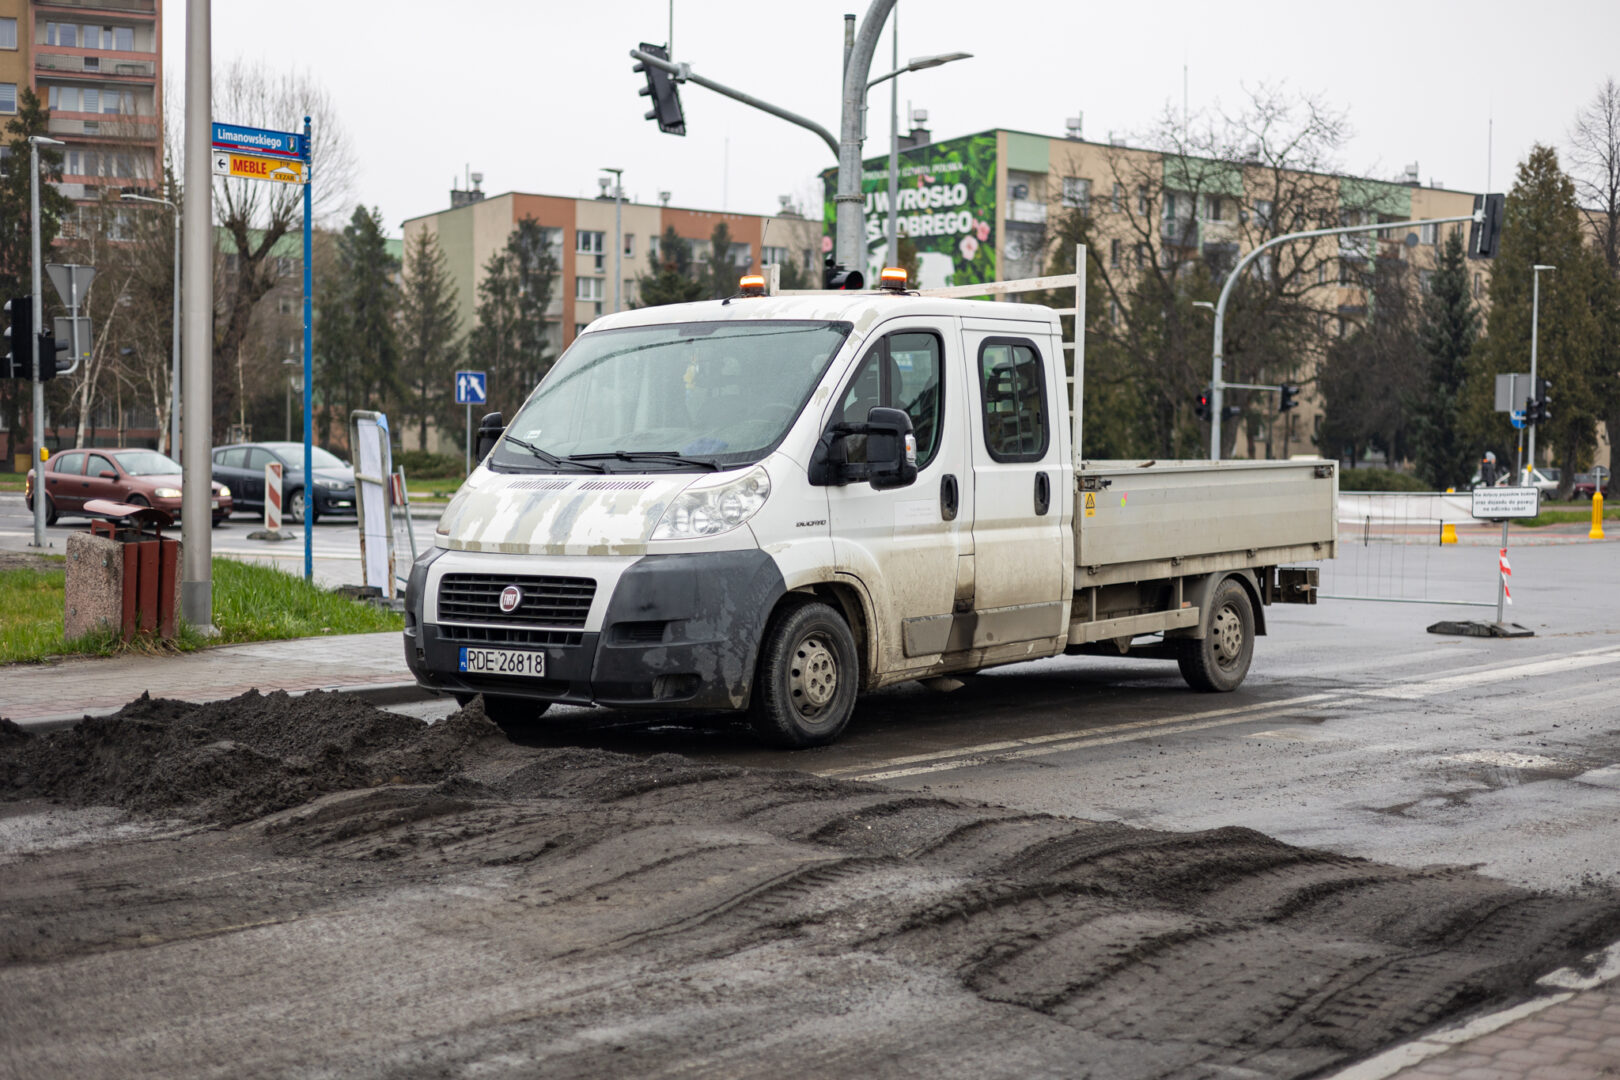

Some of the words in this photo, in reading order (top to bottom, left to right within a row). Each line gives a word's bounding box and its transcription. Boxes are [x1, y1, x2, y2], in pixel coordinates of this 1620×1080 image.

[217, 128, 282, 149] Limanowskiego
[233, 159, 267, 175] MEBLE
[503, 593, 517, 606] FIAT
[468, 650, 495, 671] RDE
[499, 652, 543, 674] 26818
